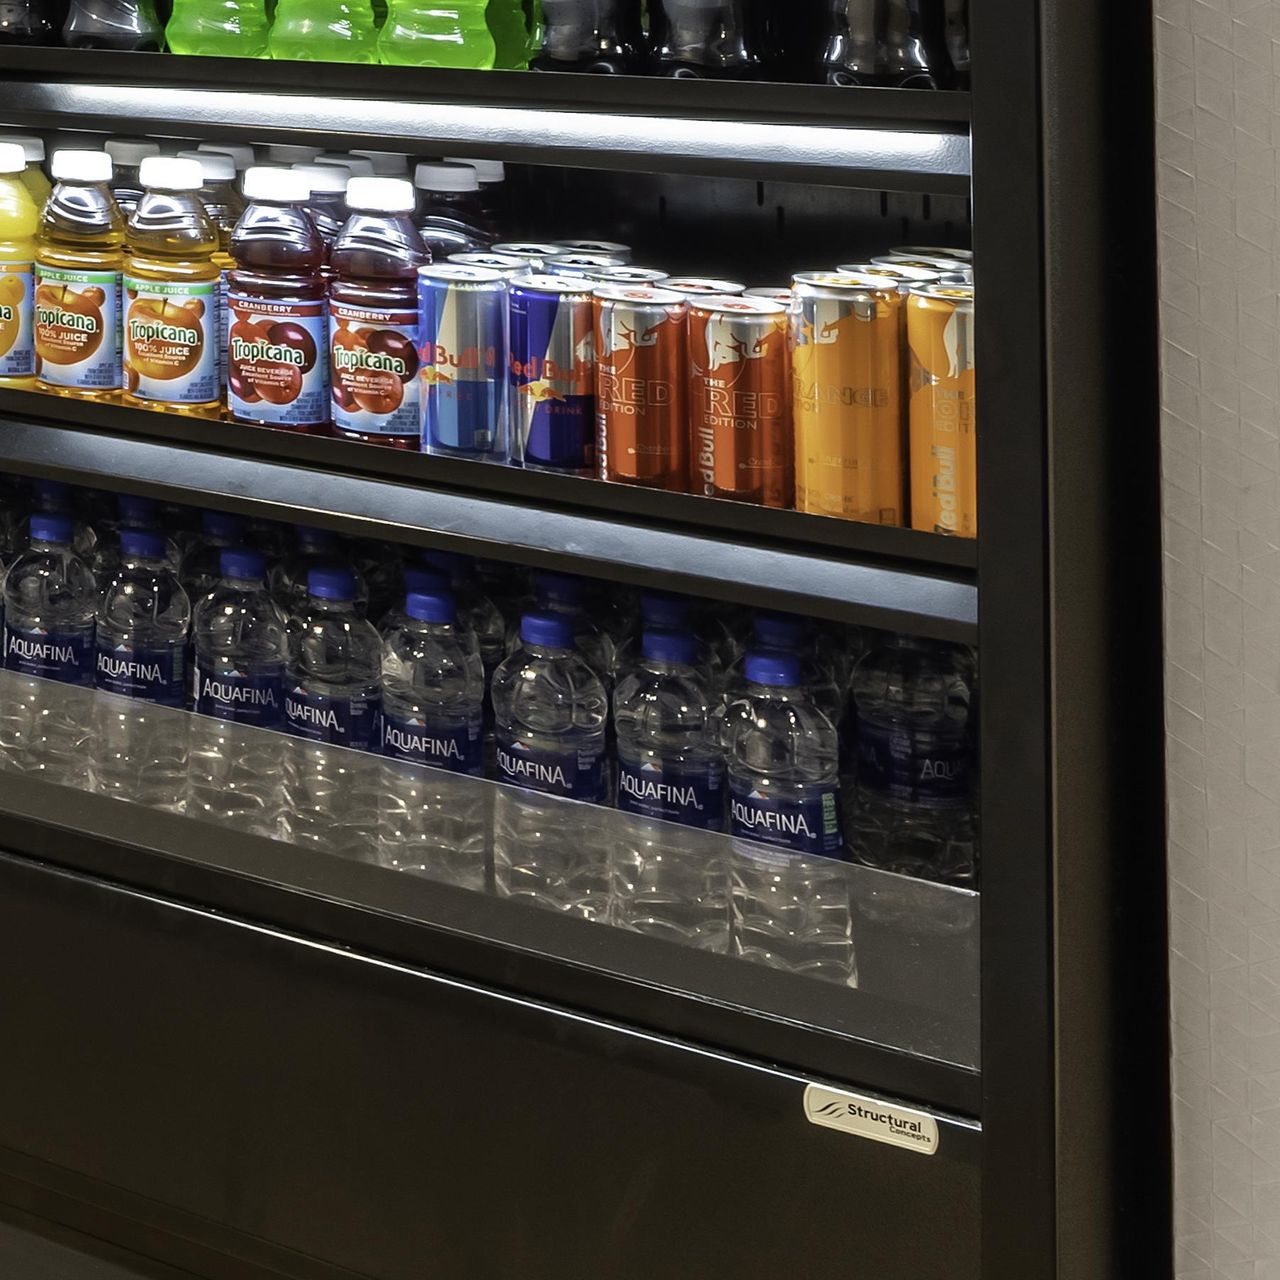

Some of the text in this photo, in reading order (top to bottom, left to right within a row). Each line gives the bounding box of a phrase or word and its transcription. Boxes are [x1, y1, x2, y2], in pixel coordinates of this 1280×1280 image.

[135, 283, 189, 295] APPLE JUICE
[238, 301, 292, 313] CRANBERRY
[338, 307, 391, 321] CRANBERRY
[130, 320, 197, 346] Tropicana
[134, 341, 190, 356] 100% JUICE
[232, 338, 304, 365] Tropicana
[704, 377, 726, 388] THE
[704, 386, 783, 420] RED
[9, 635, 76, 664] AQUAFINA
[847, 1103, 922, 1134] Structural
[890, 1125, 932, 1143] Concepts
